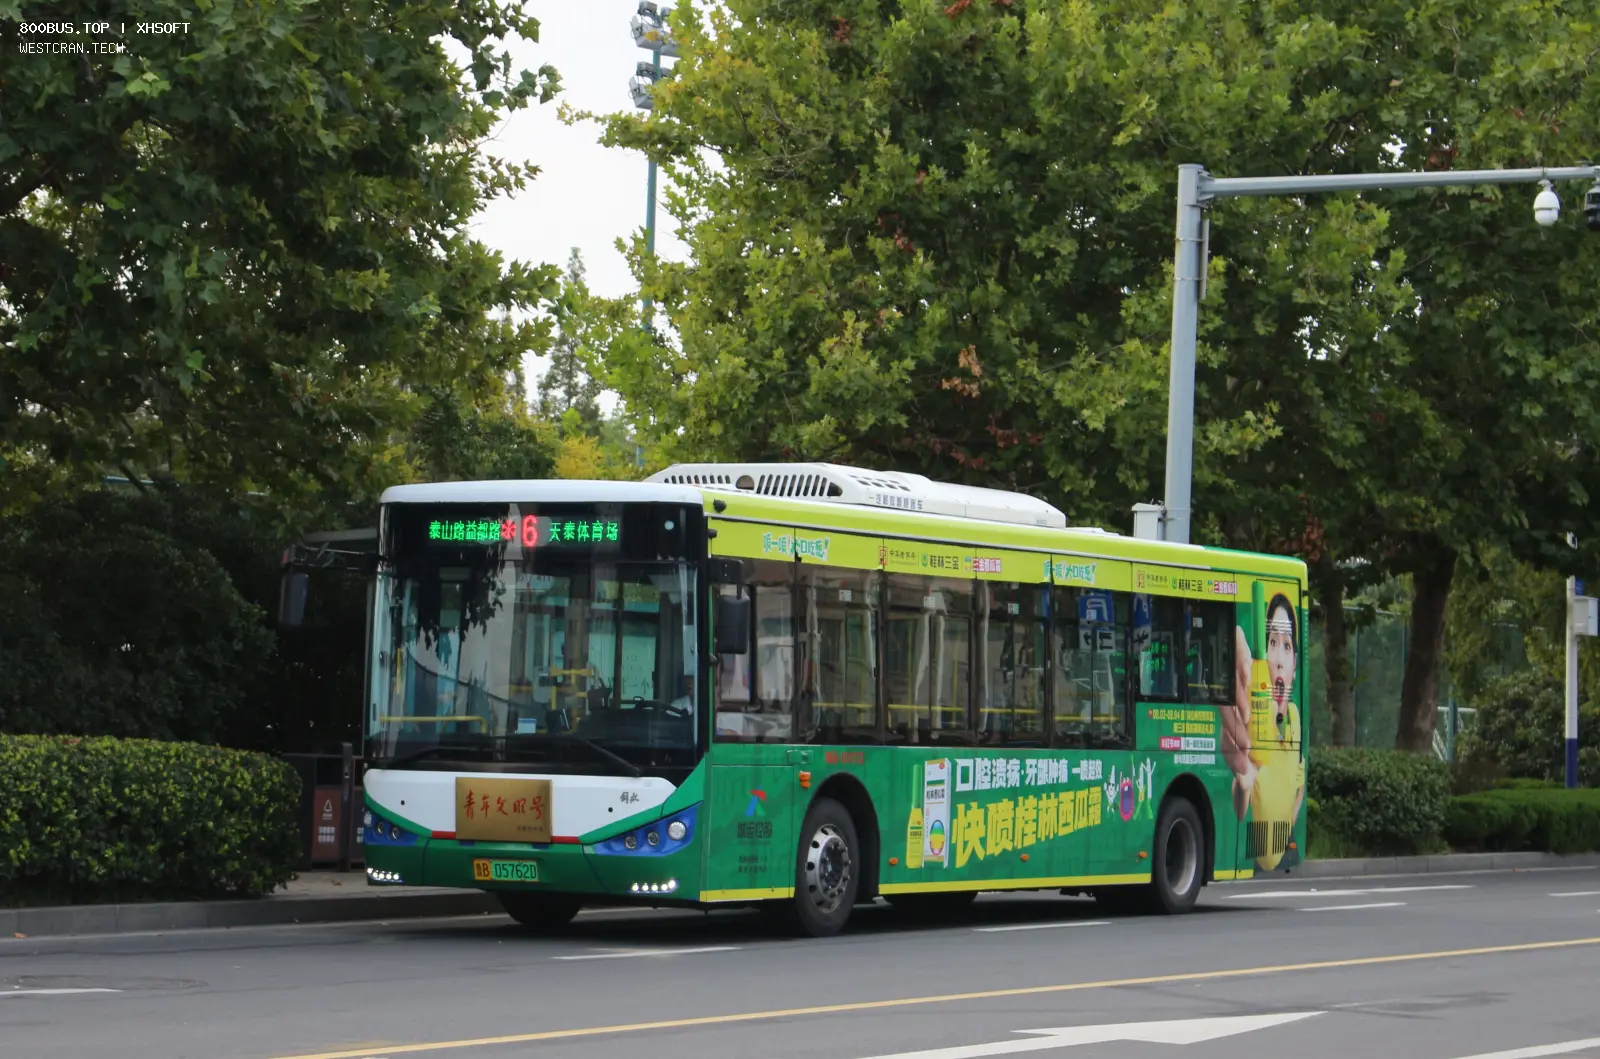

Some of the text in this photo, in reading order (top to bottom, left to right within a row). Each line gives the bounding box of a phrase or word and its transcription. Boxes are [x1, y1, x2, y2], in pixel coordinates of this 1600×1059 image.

[549, 519, 619, 542] 天泰体育场
[463, 789, 545, 820] 青年文明号
[952, 786, 1102, 869] 快喷桂林西瓜霜
